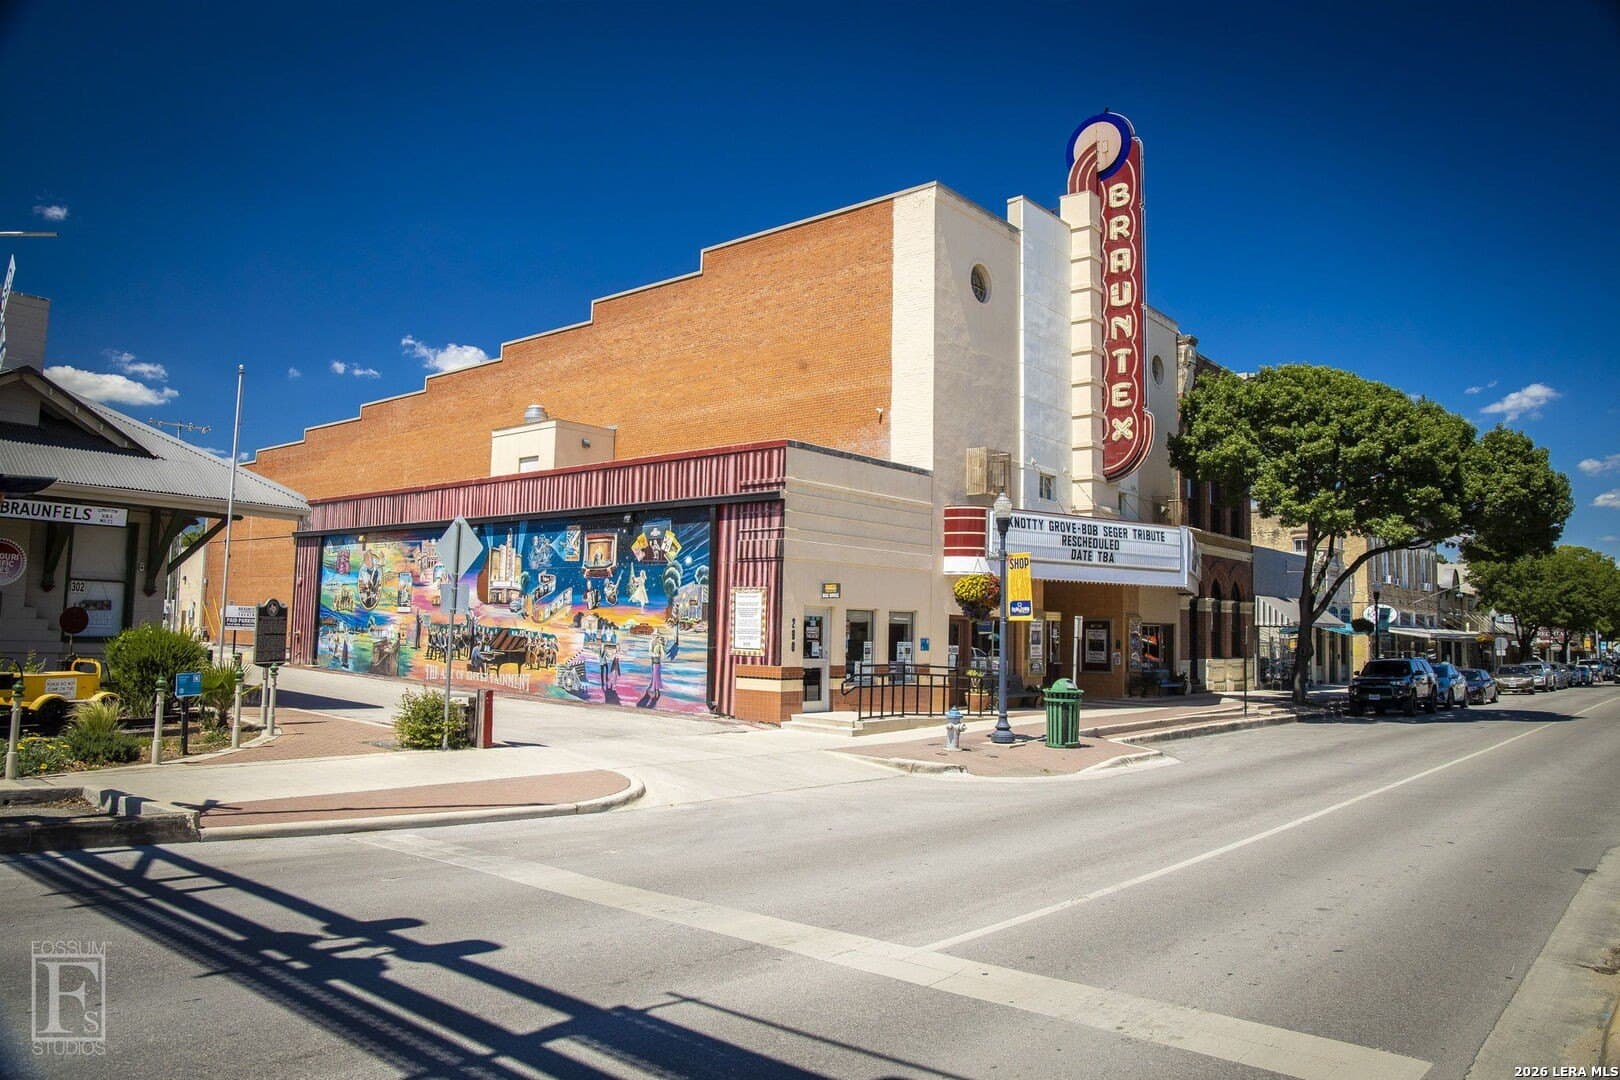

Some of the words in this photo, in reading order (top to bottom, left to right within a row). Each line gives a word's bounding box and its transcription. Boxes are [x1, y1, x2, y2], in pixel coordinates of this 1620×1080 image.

[1107, 181, 1134, 442] BRAUNTEX
[0, 501, 92, 520] BRAUNFELS
[1008, 516, 1044, 530] KNOTTY
[1049, 520, 1098, 536] GROVE-BOB
[1103, 526, 1128, 539] SEGER
[1132, 528, 1166, 542] TRIBUTE
[1061, 535, 1120, 551] RESCHEDULED
[1010, 557, 1029, 570] SHOP
[1071, 549, 1093, 562] DATE
[1098, 551, 1115, 564] TBA
[71, 582, 85, 592] 302
